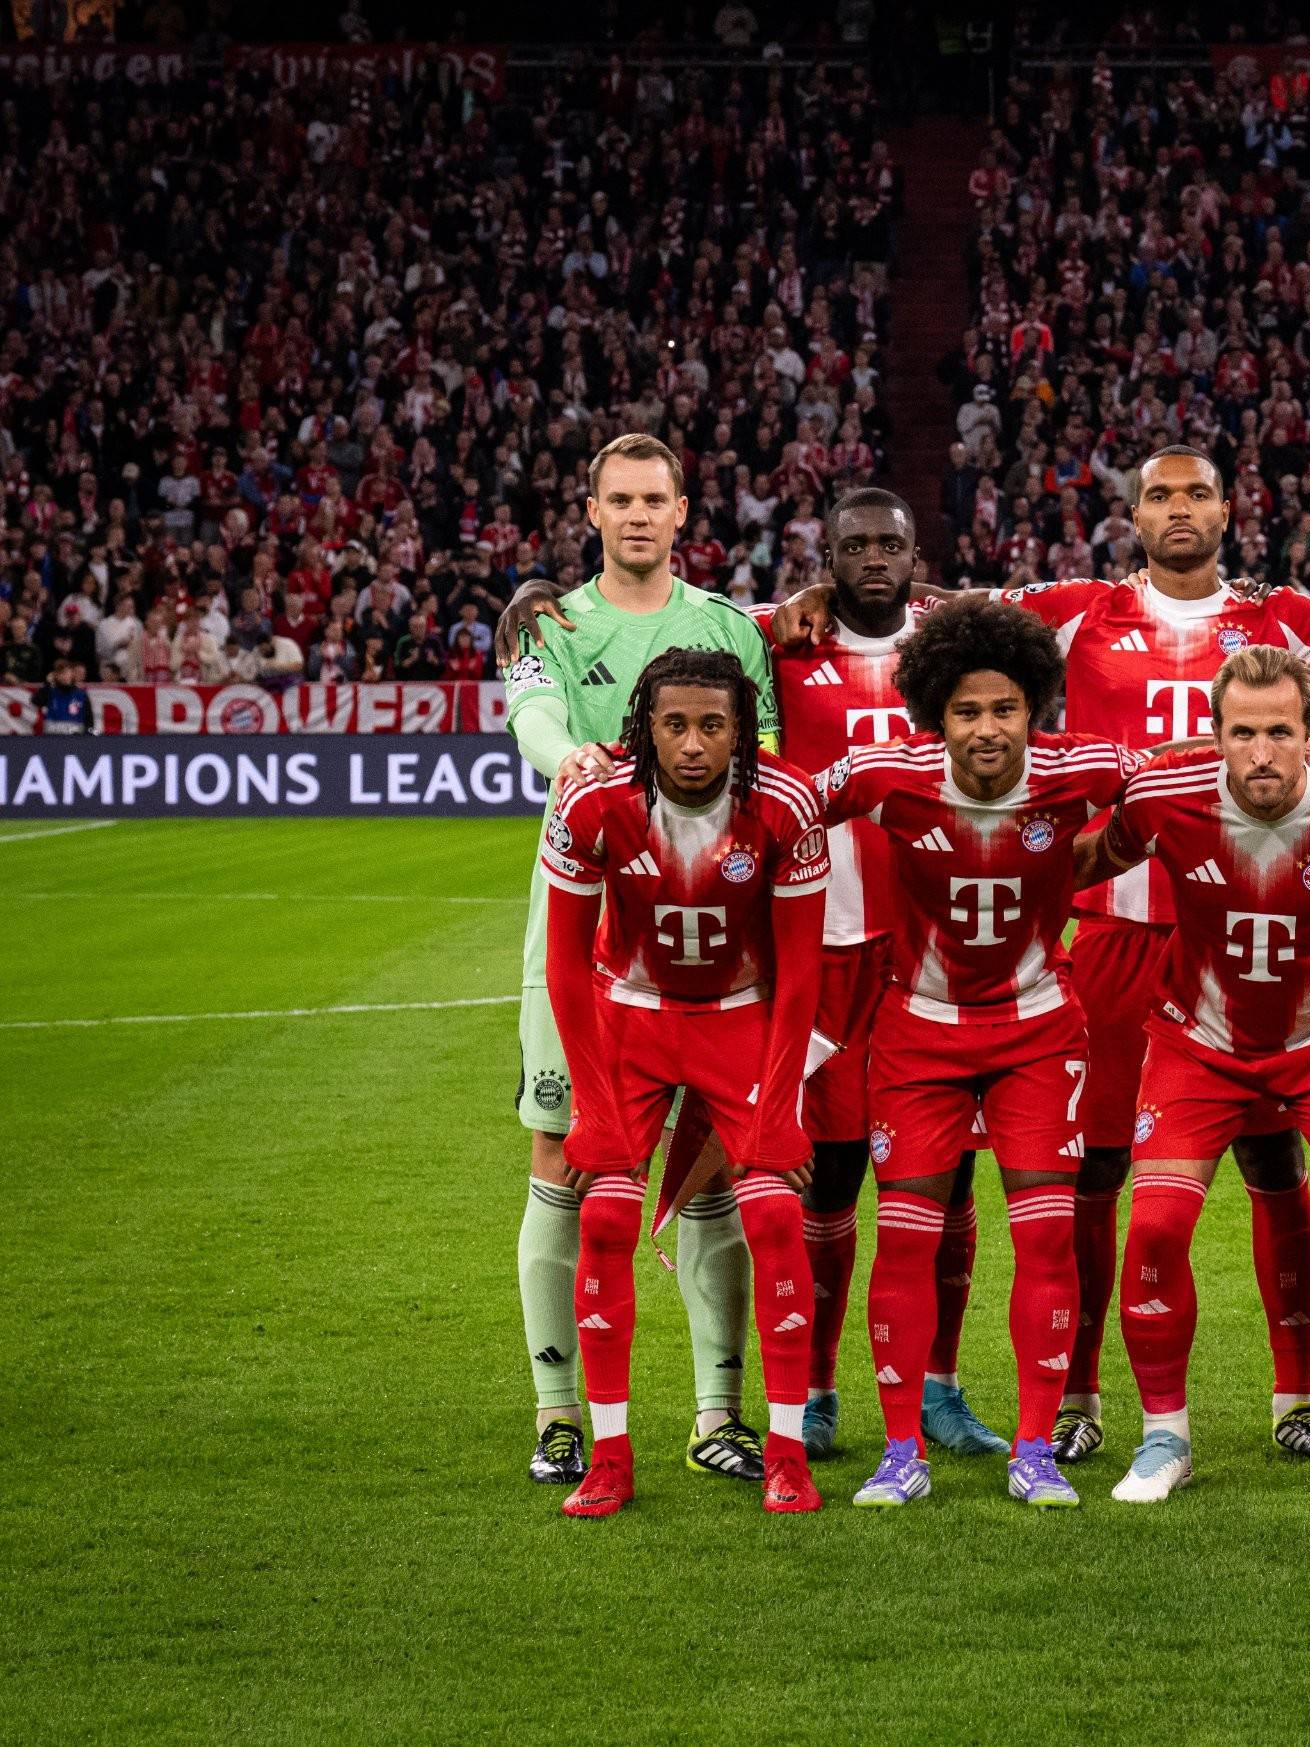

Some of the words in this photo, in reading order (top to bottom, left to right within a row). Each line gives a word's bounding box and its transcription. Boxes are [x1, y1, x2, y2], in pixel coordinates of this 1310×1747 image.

[156, 684, 448, 735] POWER
[0, 754, 320, 804] AMPIONS
[655, 905, 727, 966] T
[950, 877, 1022, 946] T
[1226, 911, 1297, 982] T
[1065, 1060, 1087, 1122] 7
